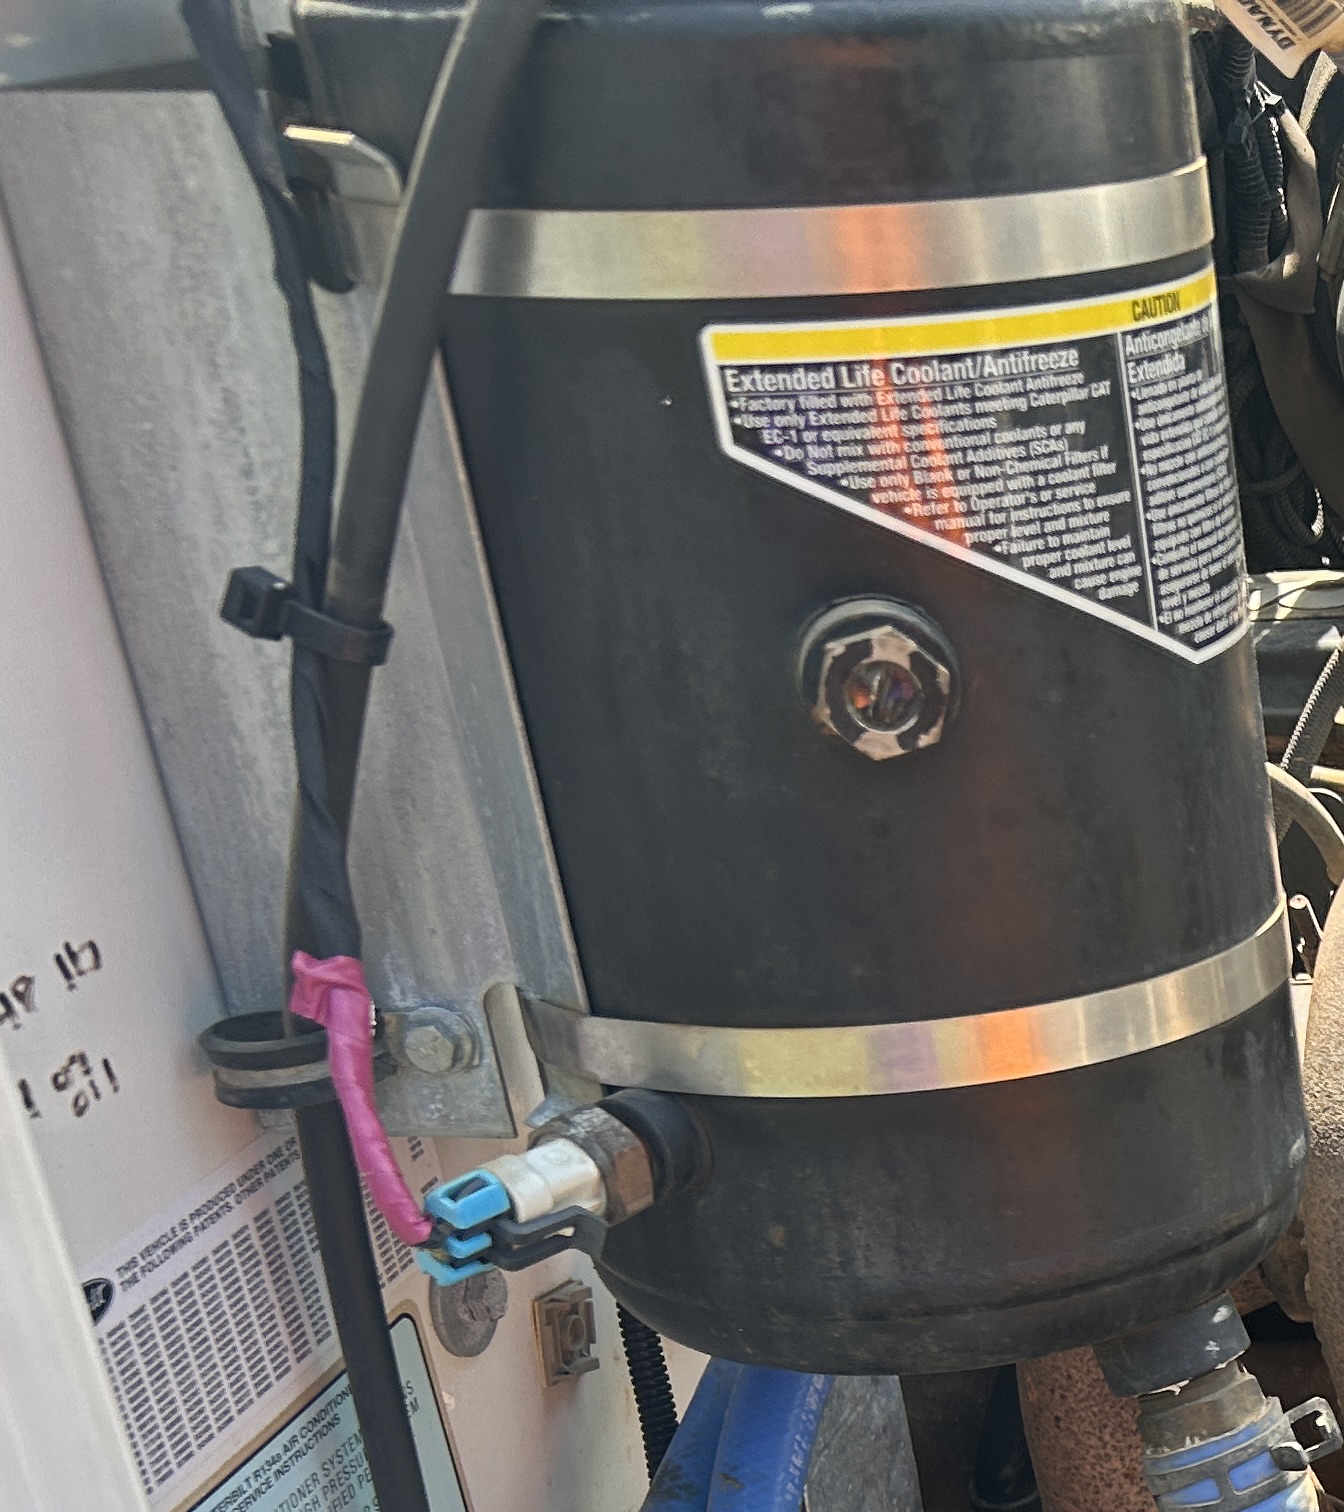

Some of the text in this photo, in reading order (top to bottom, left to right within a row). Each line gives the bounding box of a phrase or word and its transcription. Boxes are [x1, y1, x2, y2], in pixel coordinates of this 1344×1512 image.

[1246, 0, 1297, 50] DYNAC
[1132, 292, 1181, 321] CAUTION
[724, 348, 1080, 393] Extended Life Coolant/Antifreeze
[740, 372, 1085, 412] Factory filled with Extended Life Coolant Antifreeze
[809, 387, 1088, 425] Extended Caterpillar
[762, 422, 899, 444] EC-1 equivalent
[994, 427, 1047, 443] coolants
[807, 445, 1026, 476] Supplemental Additives
[973, 454, 1062, 477] Non-Chemical
[942, 469, 1090, 501] equipped with coolant
[934, 500, 1082, 531] manual instructions
[964, 511, 1110, 547] proper mixture
[1062, 527, 1110, 544] maintain
[1022, 535, 1131, 570] proper coolant level
[1073, 557, 1114, 574] mixture
[1073, 565, 1142, 589] cause engine
[1099, 581, 1139, 600] damage
[139, 1226, 178, 1260] VEHICLE
[179, 1218, 189, 1231] IS
[189, 1182, 236, 1222] PRODUCED
[237, 1160, 266, 1187] UNDER
[266, 1146, 284, 1165] ONE
[140, 1232, 193, 1277] FOLLOWING
[234, 1178, 264, 1204] OTHER
[274, 1413, 341, 1482] INSTRUCTIONS
[282, 1435, 299, 1457] AIR
[322, 1453, 366, 1498] PRESSU
